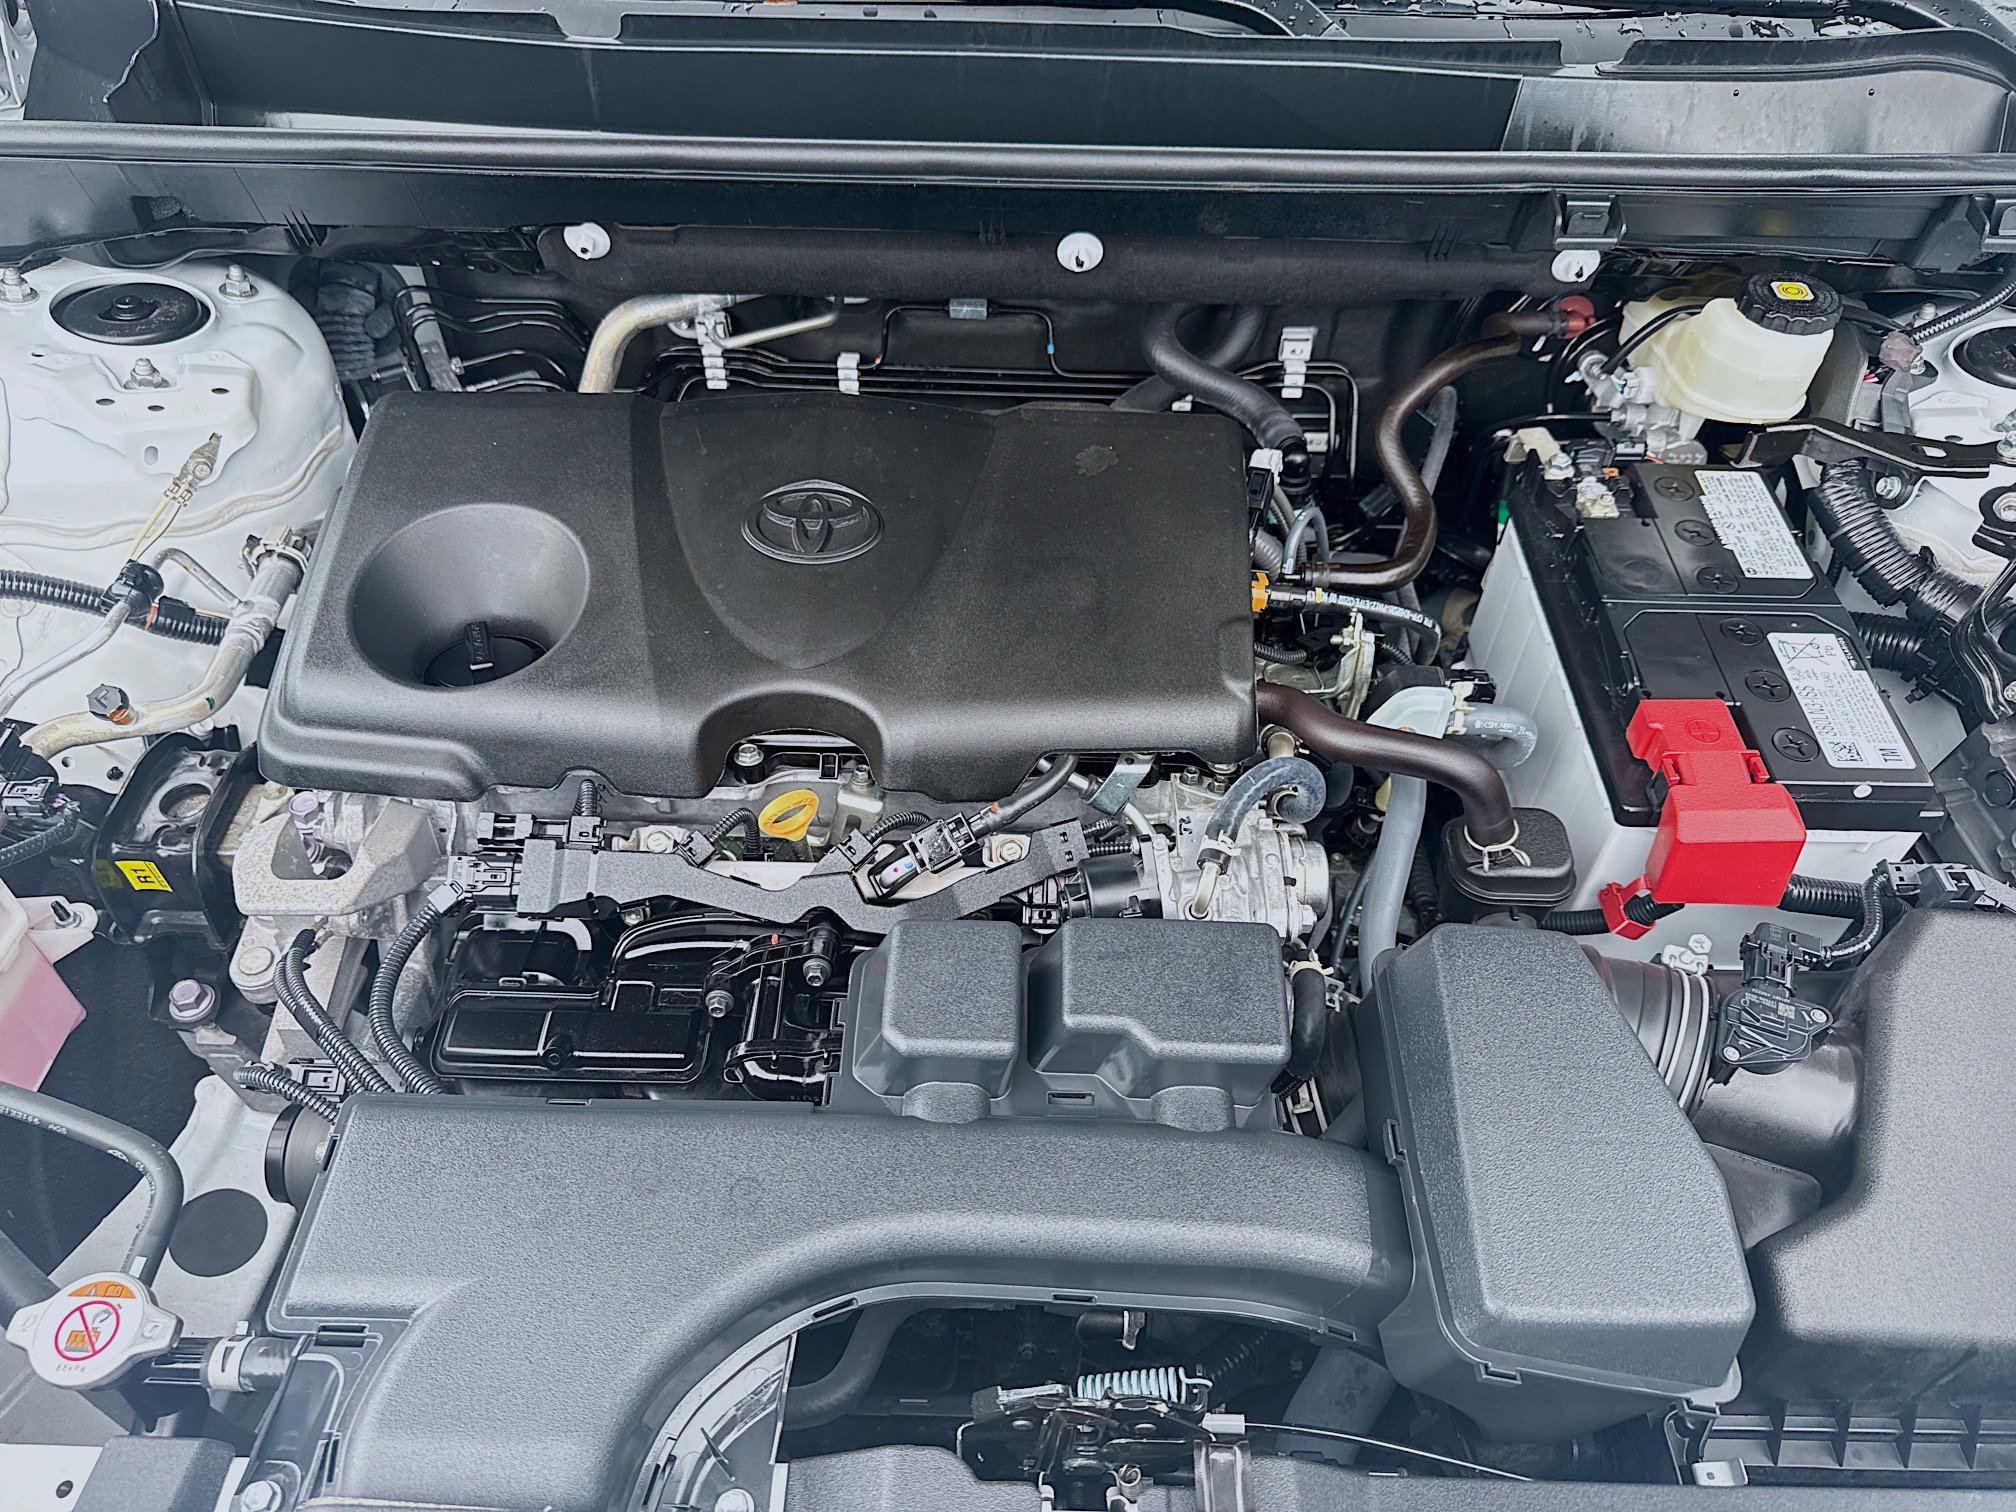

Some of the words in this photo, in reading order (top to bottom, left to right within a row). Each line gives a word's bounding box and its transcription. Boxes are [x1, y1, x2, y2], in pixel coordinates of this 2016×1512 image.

[1824, 645, 1837, 657] Pb
[1837, 636, 1854, 660] CLARIOS
[1796, 684, 1838, 737] 380LN3-ISS
[1878, 747, 1903, 763] TM
[130, 868, 156, 884] R1
